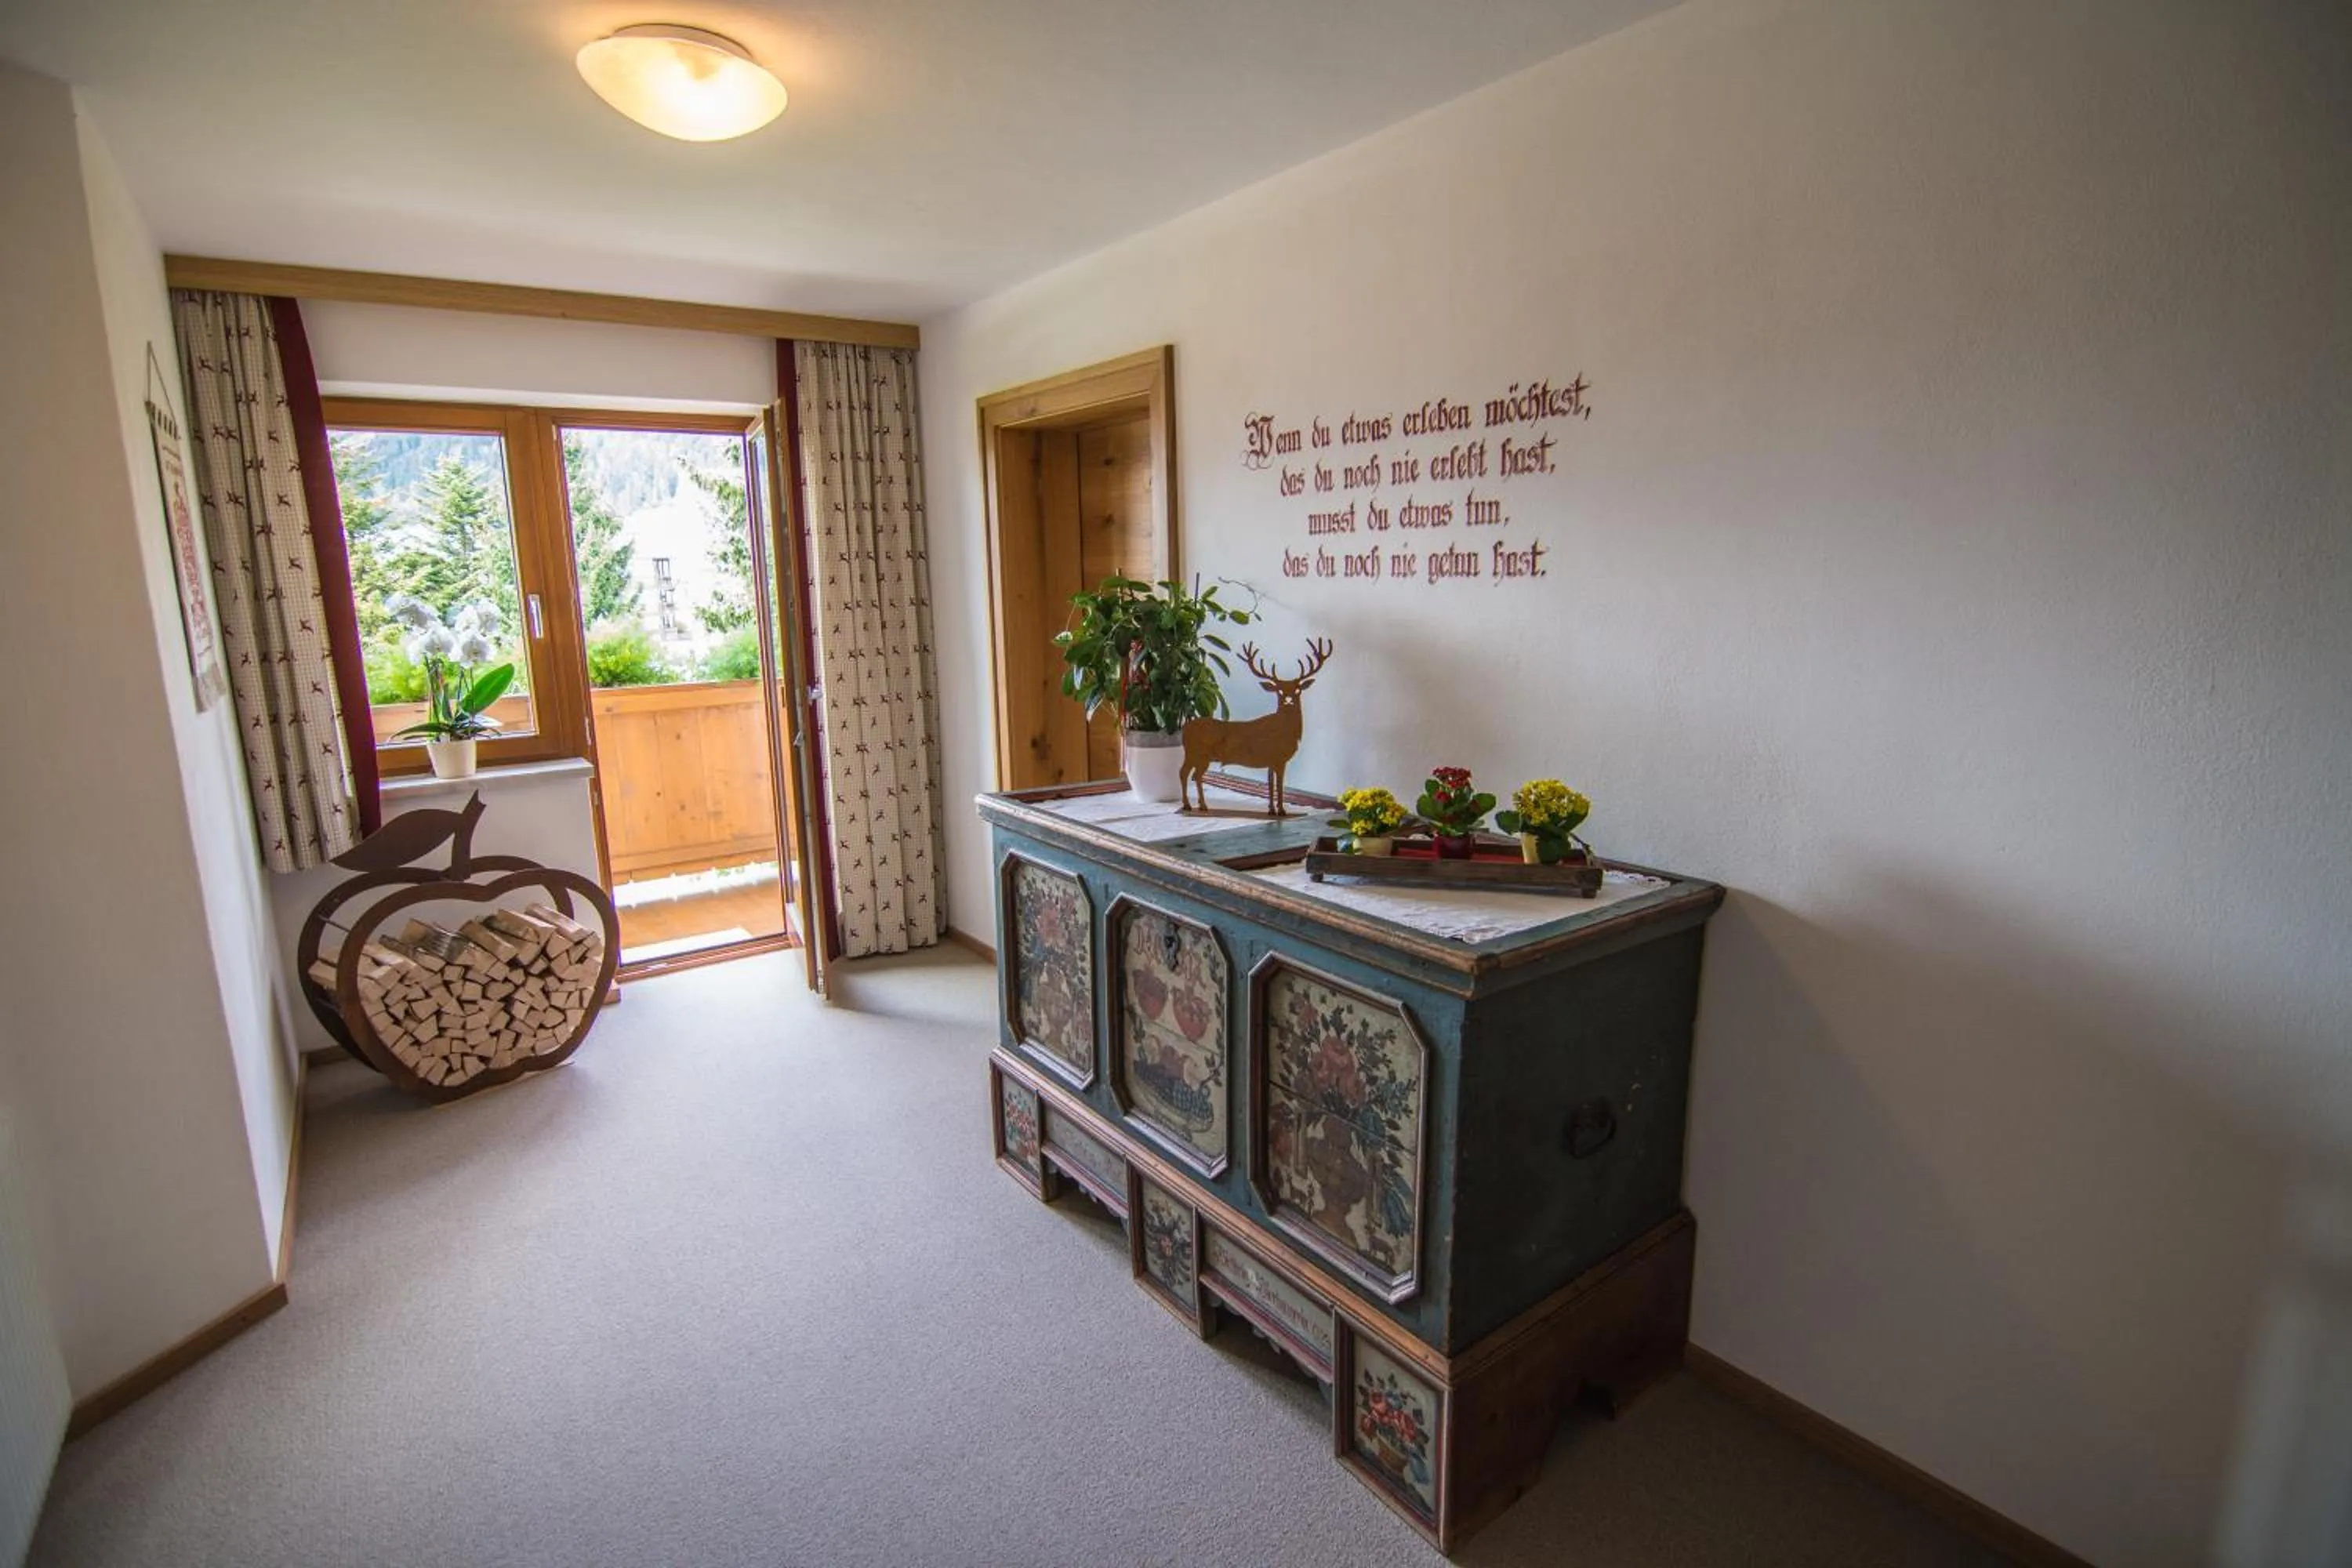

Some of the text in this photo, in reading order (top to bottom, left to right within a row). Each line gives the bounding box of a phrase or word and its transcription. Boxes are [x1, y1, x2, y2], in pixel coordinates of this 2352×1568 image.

[1243, 371, 1592, 468] Wenn du etwas erleben möchtest,
[1280, 431, 1559, 497] das du noch nie erlebt hast,
[1308, 487, 1511, 536] musst du etwas tun,
[1283, 537, 1551, 587] das du noch nie getan hast.
